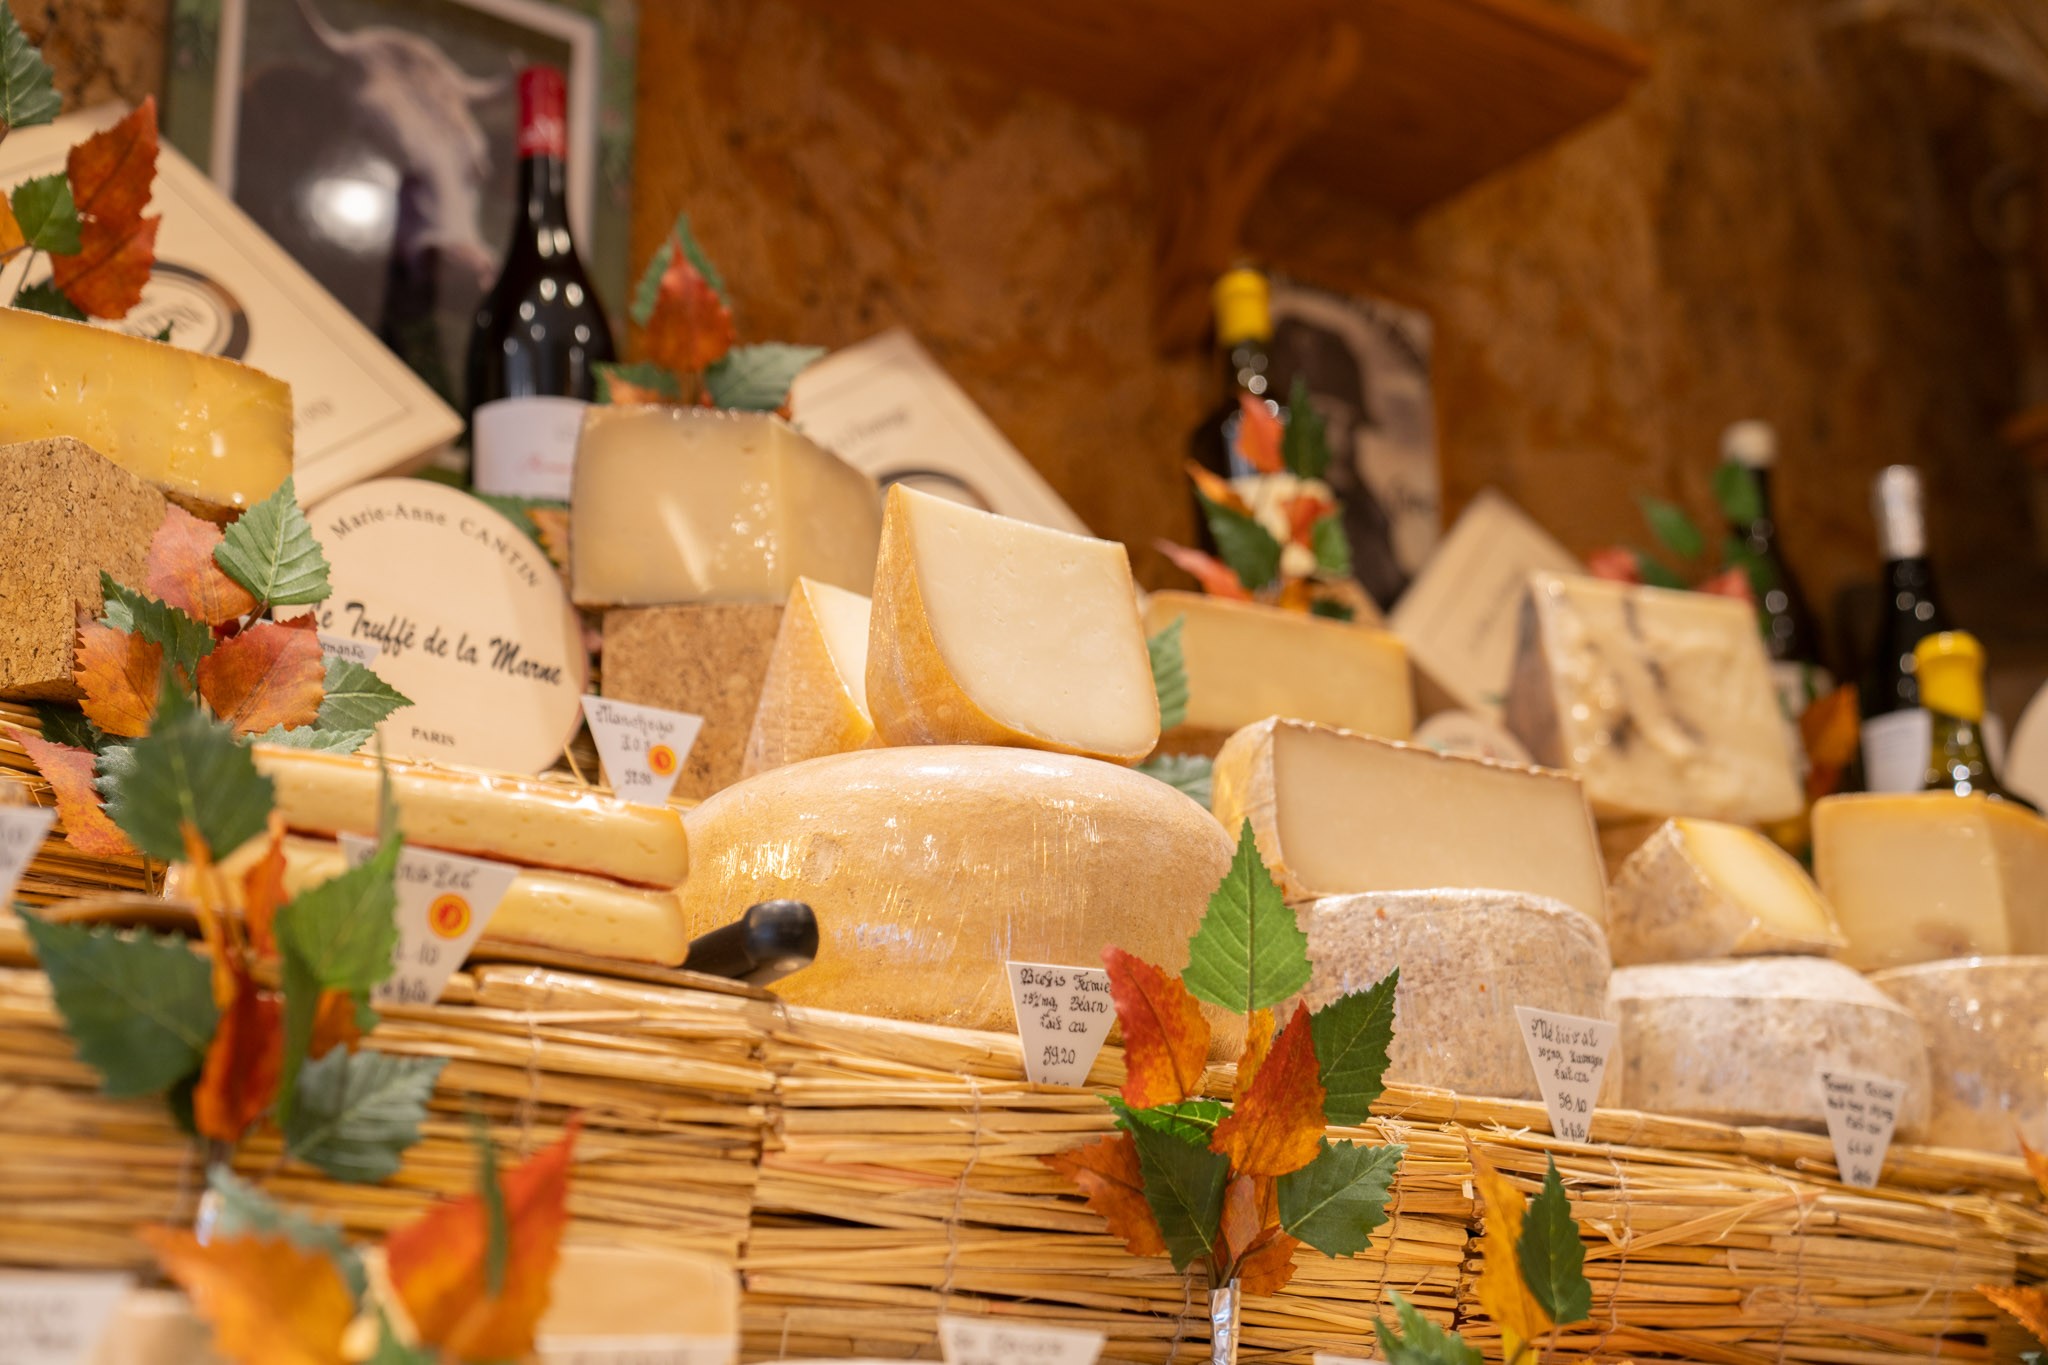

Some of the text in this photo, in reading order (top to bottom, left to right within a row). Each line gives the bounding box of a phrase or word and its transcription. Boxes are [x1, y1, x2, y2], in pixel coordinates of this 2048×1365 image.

[330, 503, 539, 587] Marie-Anne CANTIN
[423, 625, 448, 658] de
[457, 632, 478, 664] la
[489, 636, 563, 686] Marne
[411, 727, 455, 746] PARIS
[1020, 968, 1111, 993] Brebis Fermie
[1070, 995, 1108, 1013] Béarn
